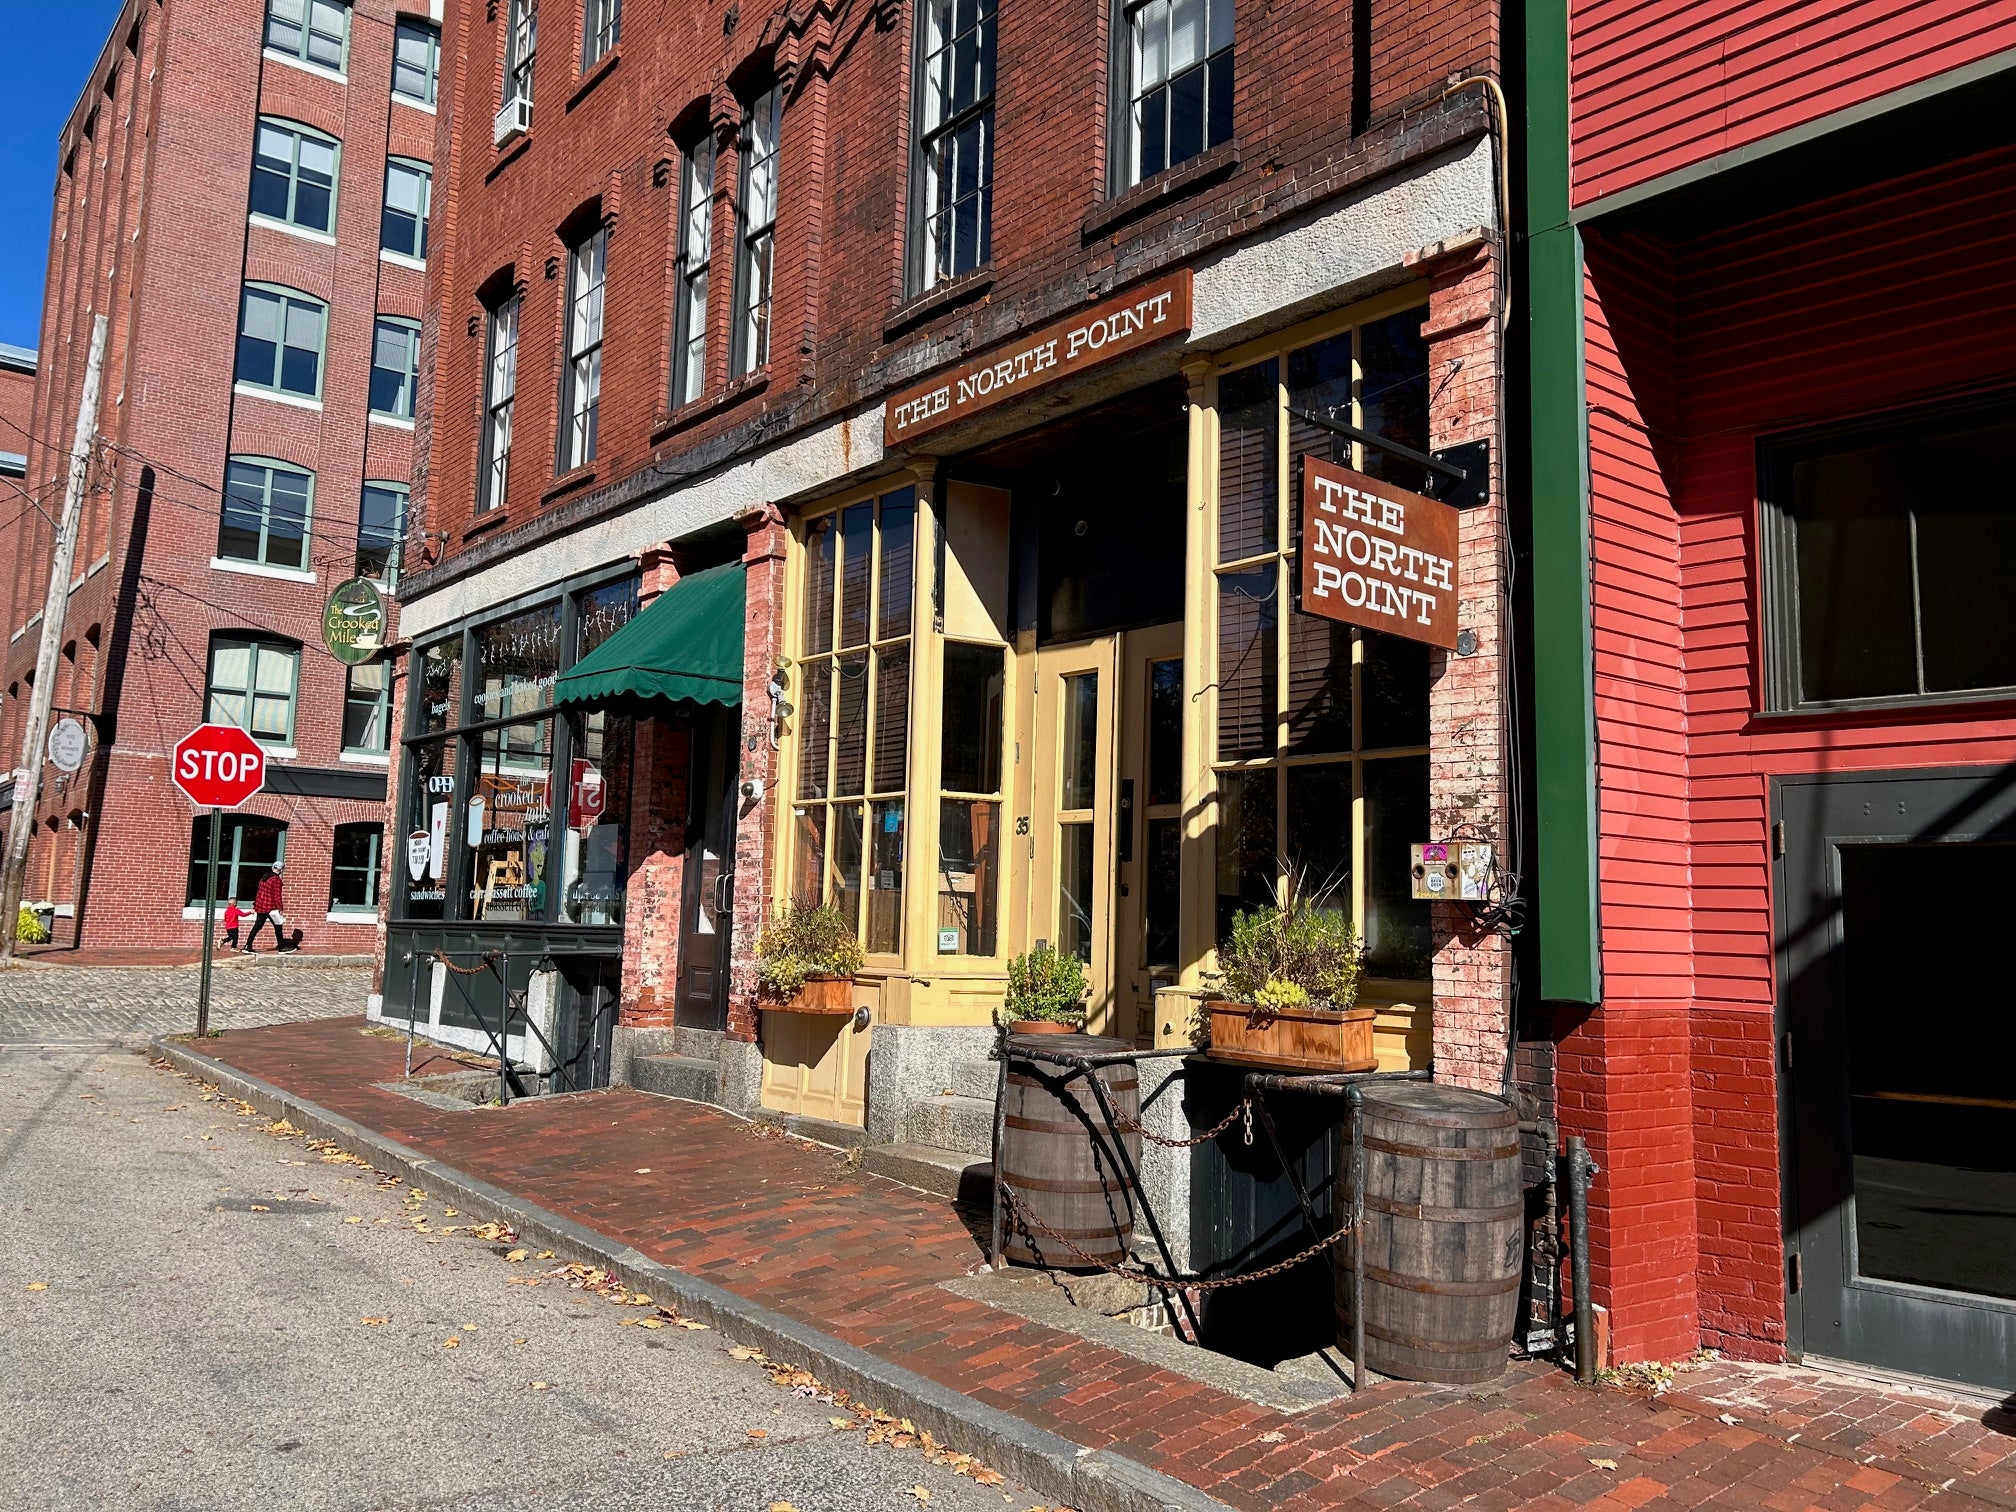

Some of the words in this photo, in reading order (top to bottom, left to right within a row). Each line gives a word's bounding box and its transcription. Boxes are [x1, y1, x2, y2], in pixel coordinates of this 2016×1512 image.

[894, 385, 950, 430] THE
[957, 340, 1058, 404] NORTH
[1066, 291, 1172, 359] POINT
[1314, 475, 1405, 535] THE
[1313, 518, 1454, 591] NORTH
[1312, 562, 1437, 626] POINT
[331, 604, 343, 615] The
[328, 616, 379, 631] Crooked
[329, 629, 357, 643] Mile
[500, 683, 513, 697] and
[538, 670, 559, 691] good
[180, 748, 259, 783] STOP
[429, 776, 455, 793] OPEN
[495, 783, 534, 808] crooked
[1016, 816, 1029, 836] 35
[410, 887, 445, 901] sandwiches
[469, 886, 513, 899] carraassett
[513, 884, 538, 899] coffee
